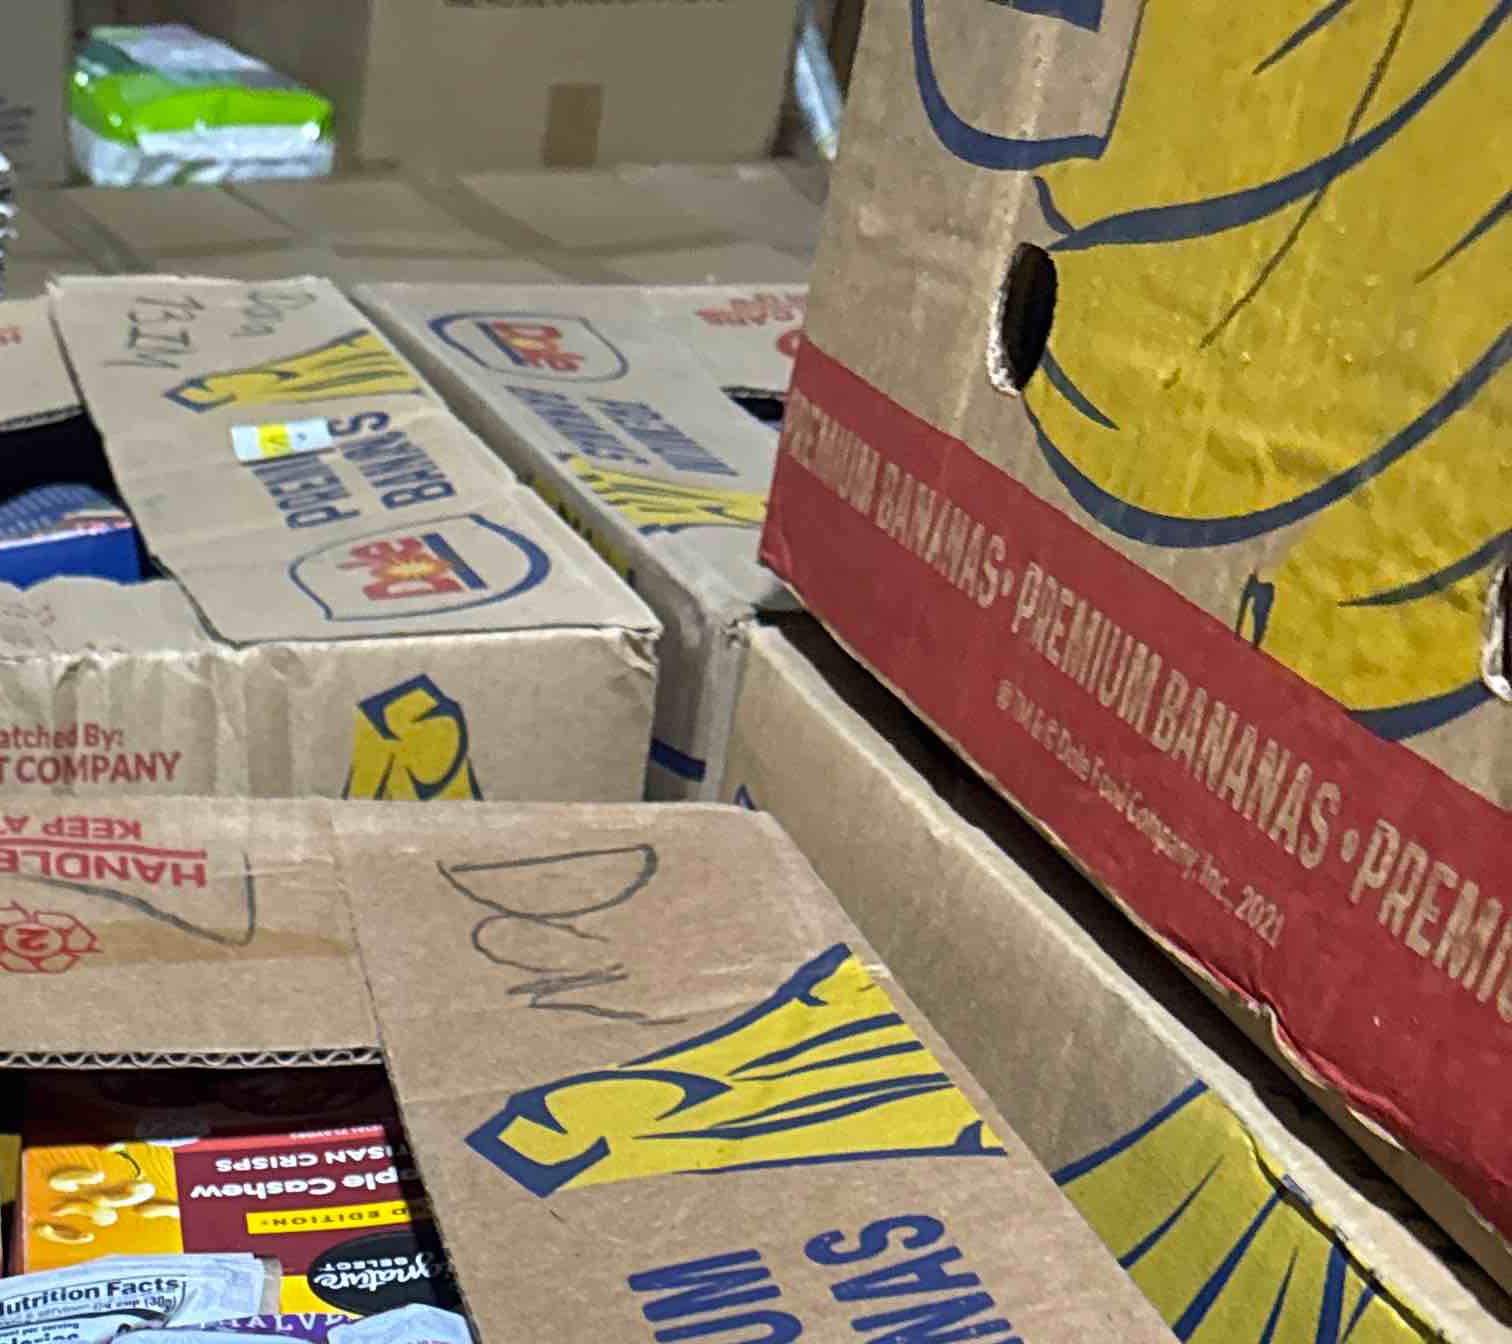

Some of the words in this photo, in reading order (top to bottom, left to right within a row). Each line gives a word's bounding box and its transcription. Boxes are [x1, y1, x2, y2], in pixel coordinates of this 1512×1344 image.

[876, 462, 1007, 609] BANANAS
[1011, 560, 1163, 734] PREMIUM
[1151, 670, 1341, 870] BANANAS
[83, 723, 126, 753] By:
[16, 751, 183, 786] COMPANY
[42, 814, 144, 842] KEEP
[215, 1151, 320, 1173] CRISPS
[190, 1175, 337, 1201] Cashew
[106, 1277, 179, 1298] Facts
